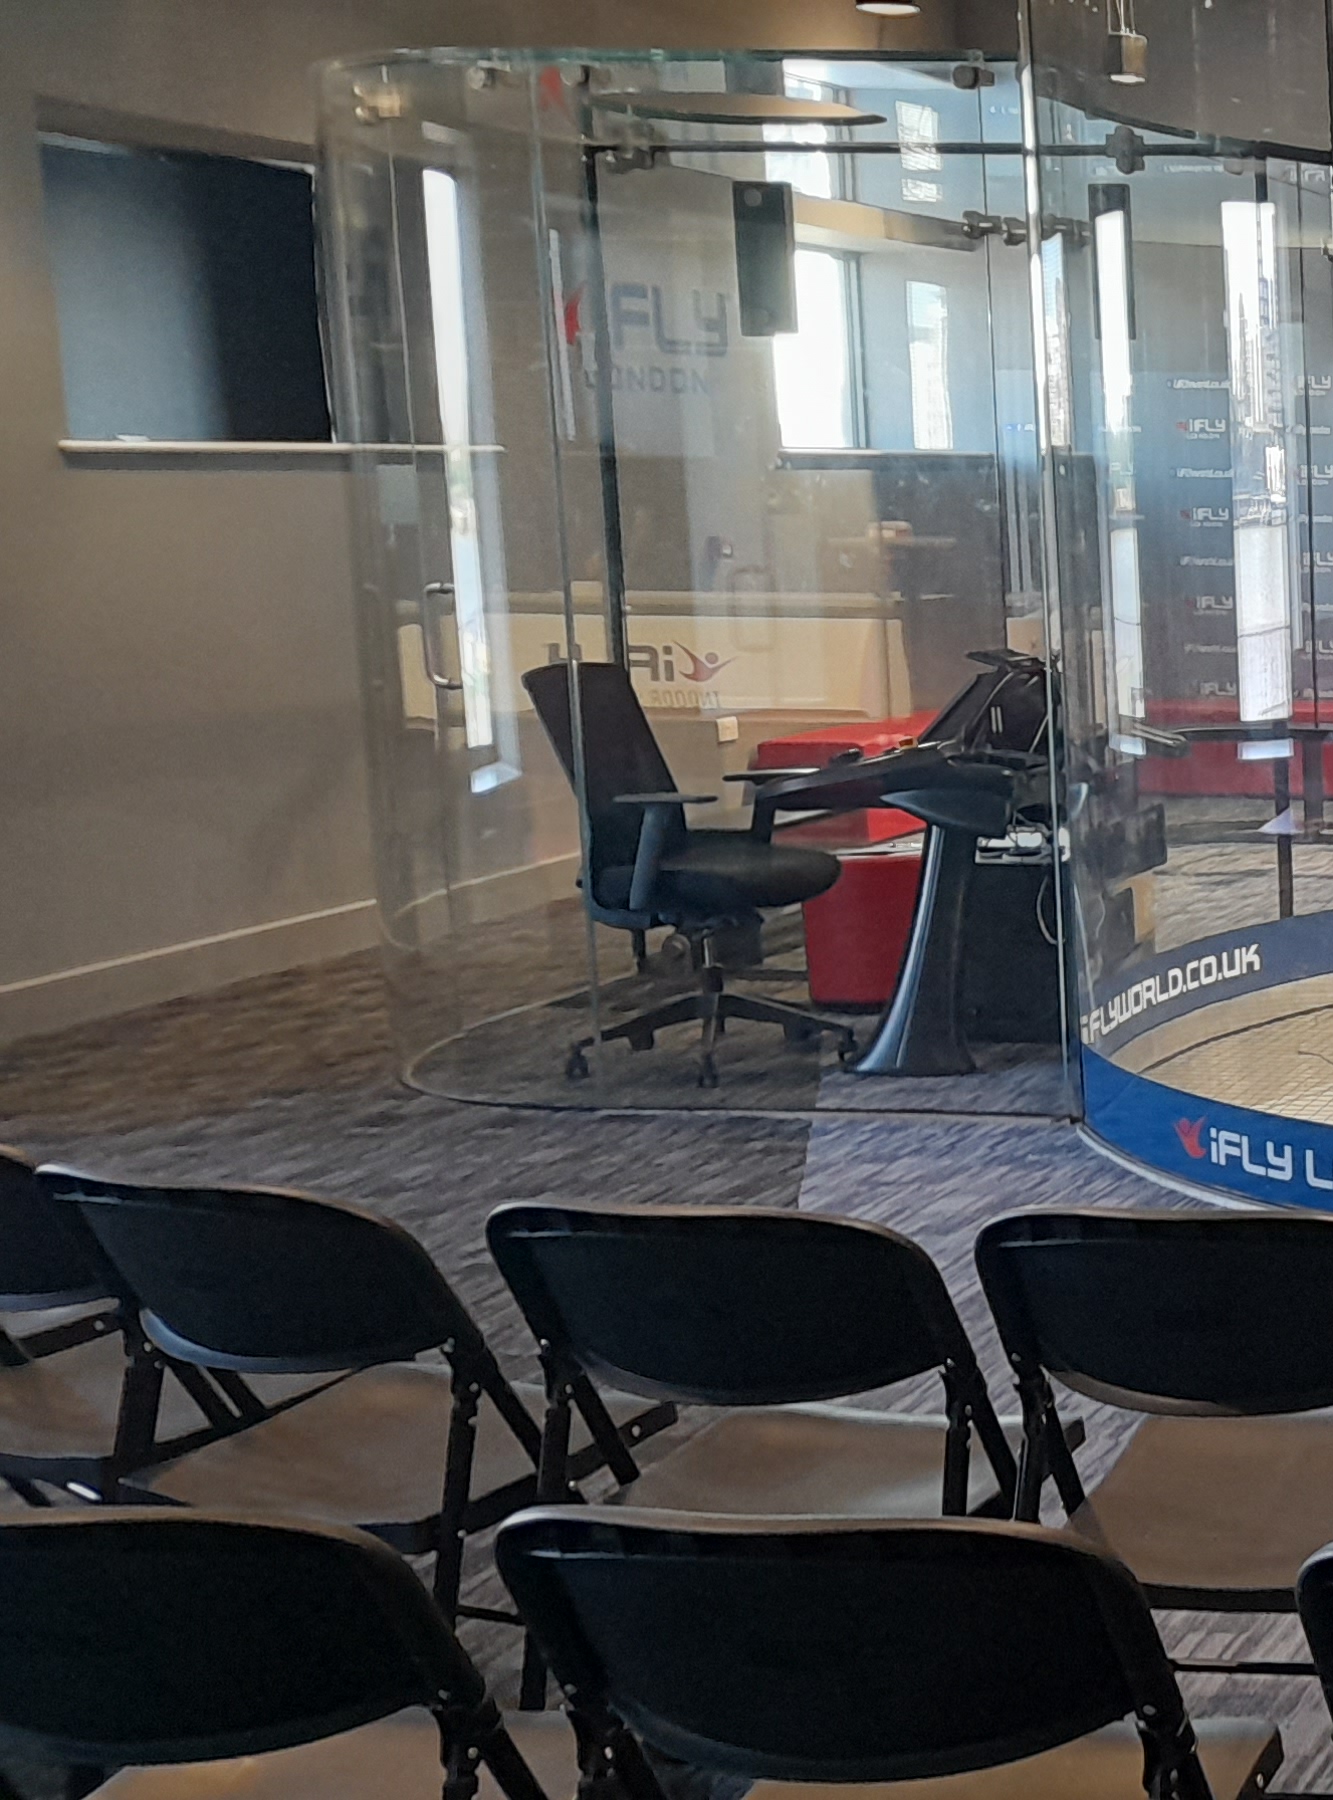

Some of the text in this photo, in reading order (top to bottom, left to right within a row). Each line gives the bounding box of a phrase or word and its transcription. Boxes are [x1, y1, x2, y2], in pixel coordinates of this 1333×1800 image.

[600, 283, 728, 358] FLY
[1080, 943, 1261, 1045] iFLYWORLD.CO.UK
[1210, 1130, 1293, 1180] iFLY
